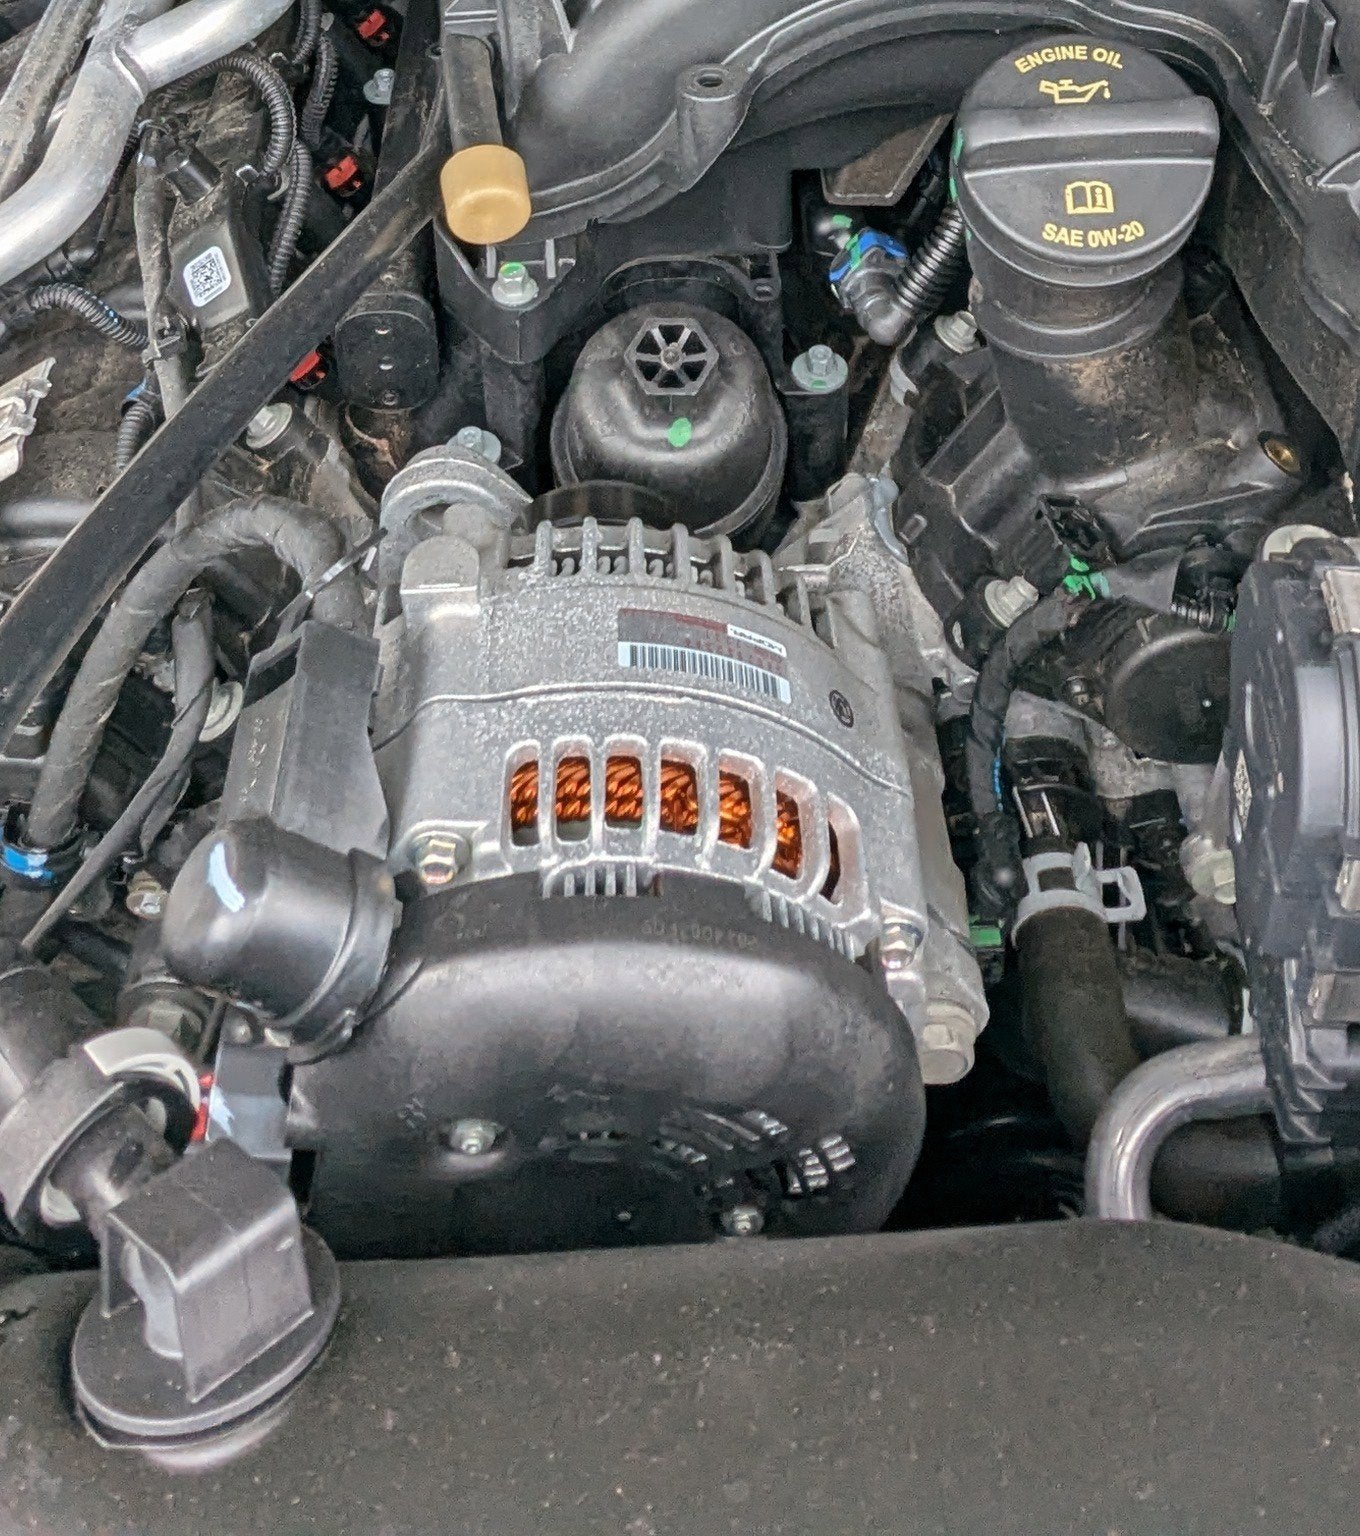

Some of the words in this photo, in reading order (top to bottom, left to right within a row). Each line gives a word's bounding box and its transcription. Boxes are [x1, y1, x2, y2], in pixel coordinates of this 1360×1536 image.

[1014, 45, 1088, 74] ENGINE
[1093, 46, 1123, 70] OIL
[1042, 223, 1084, 248] SAE
[1088, 220, 1145, 247] 0W-20
